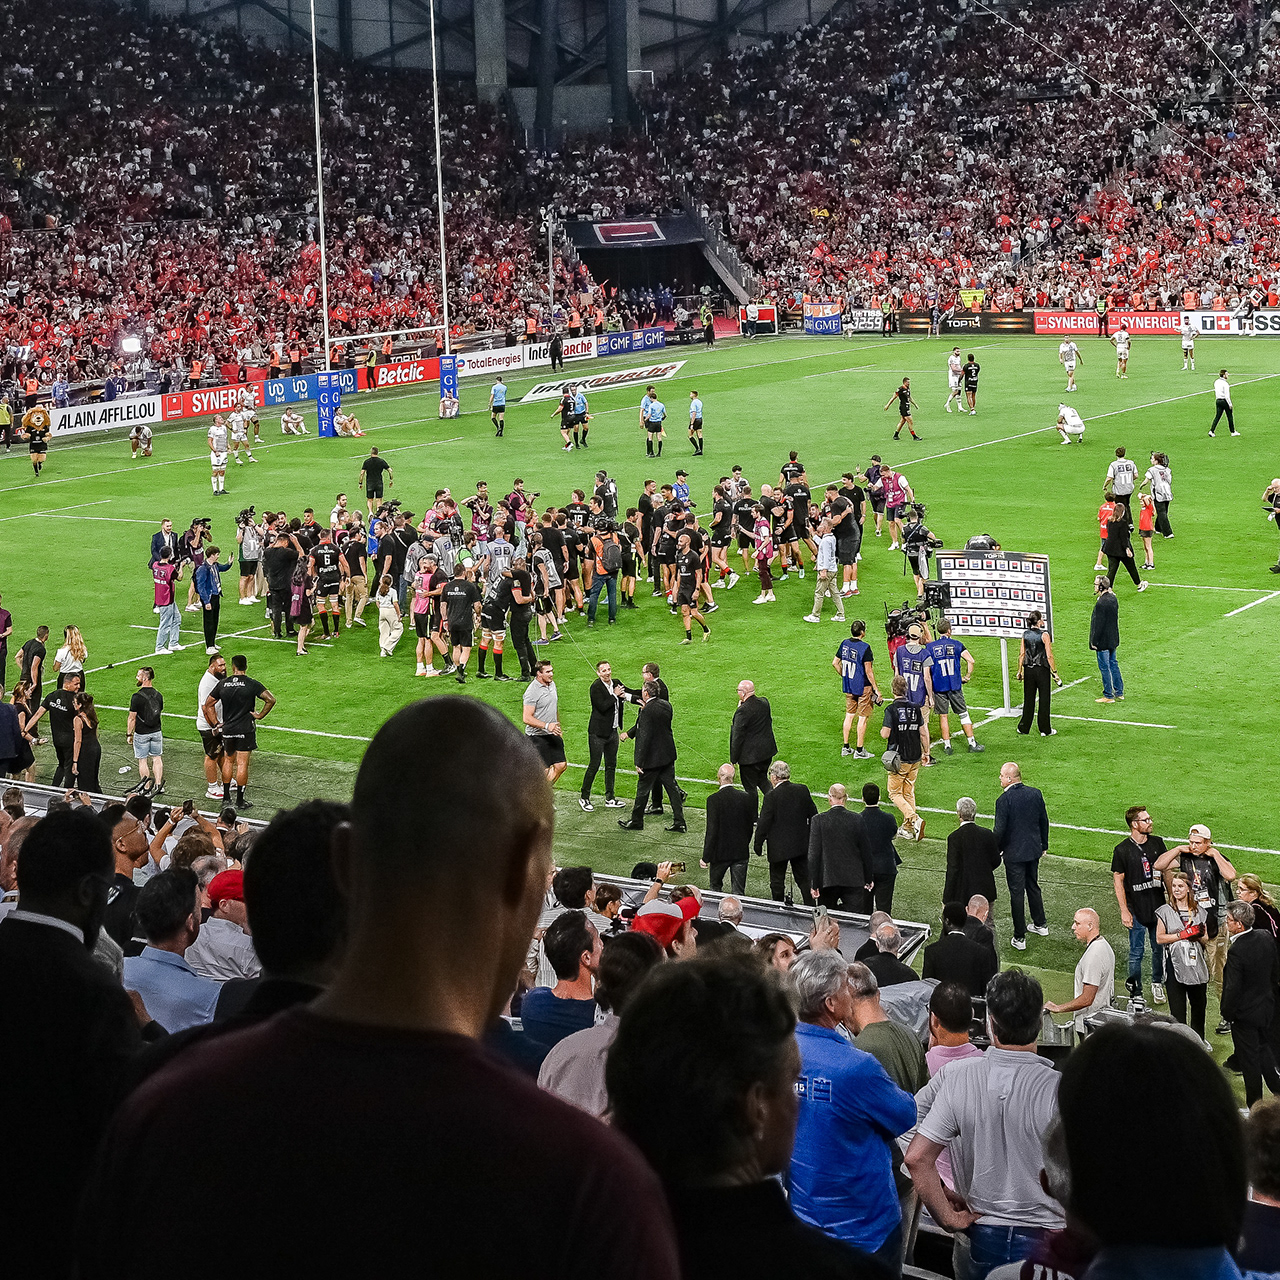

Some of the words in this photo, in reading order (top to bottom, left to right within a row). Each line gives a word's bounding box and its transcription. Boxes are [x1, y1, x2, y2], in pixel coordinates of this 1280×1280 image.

[814, 319, 838, 329] GMF
[947, 316, 980, 327] TOP14
[1049, 316, 1102, 328] SYNERGI
[1121, 316, 1179, 329] SYNERGIE
[610, 336, 631, 350] GMF
[645, 331, 664, 345] GMF
[528, 339, 593, 361] Intearché
[467, 353, 521, 370] TotalEnergies
[378, 361, 425, 386] Betclic
[192, 385, 260, 412] SYNERGE
[57, 410, 96, 430] ALAIN
[98, 401, 156, 424] AFFLELOU
[324, 554, 331, 565] 6
[841, 659, 857, 679] TV
[938, 658, 955, 677] TV
[904, 672, 920, 692] TV
